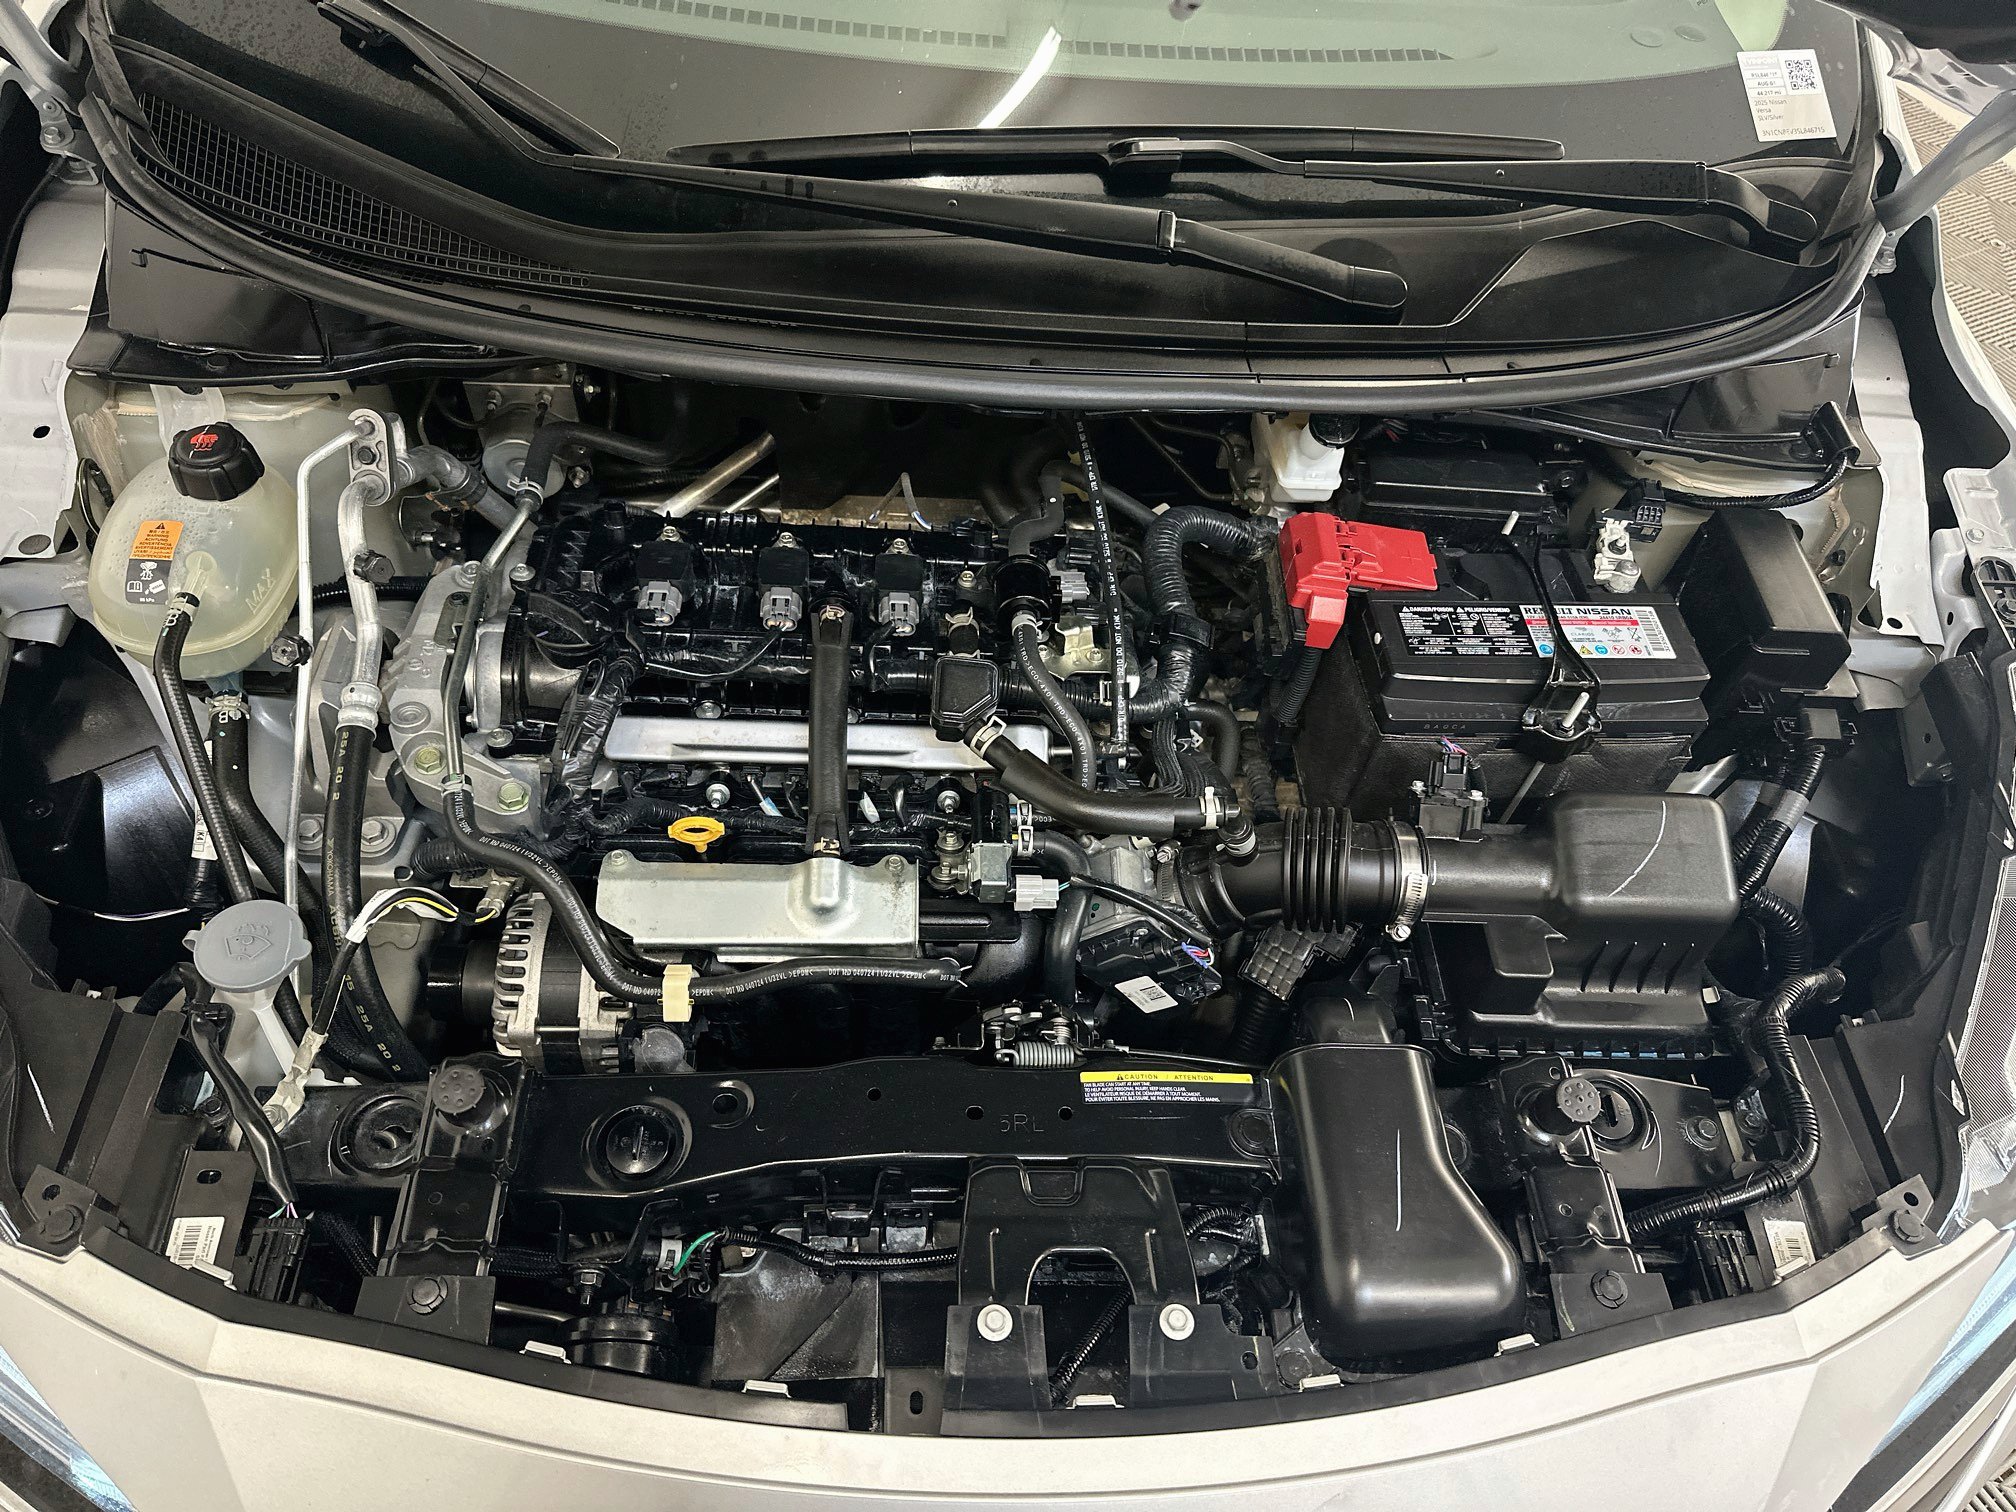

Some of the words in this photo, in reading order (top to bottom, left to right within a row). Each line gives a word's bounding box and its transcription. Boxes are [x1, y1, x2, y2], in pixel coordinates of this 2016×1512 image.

[1113, 614, 1121, 630] KINK
[1114, 632, 1122, 644] NOT
[1116, 647, 1123, 656] DO
[338, 731, 349, 757] 25A
[335, 766, 344, 783] 20
[333, 792, 340, 800] 2
[479, 836, 490, 844] DOT
[499, 841, 521, 852] 040724
[326, 850, 334, 897] YOKOHAMA
[853, 969, 875, 977] 040724
[621, 982, 632, 991] DOT
[643, 987, 663, 996] 04072
[726, 987, 735, 995] DOT
[745, 980, 763, 990] 040724
[356, 1005, 373, 1032] 25A
[377, 1042, 392, 1059] 20
[392, 1064, 401, 1072] 2
